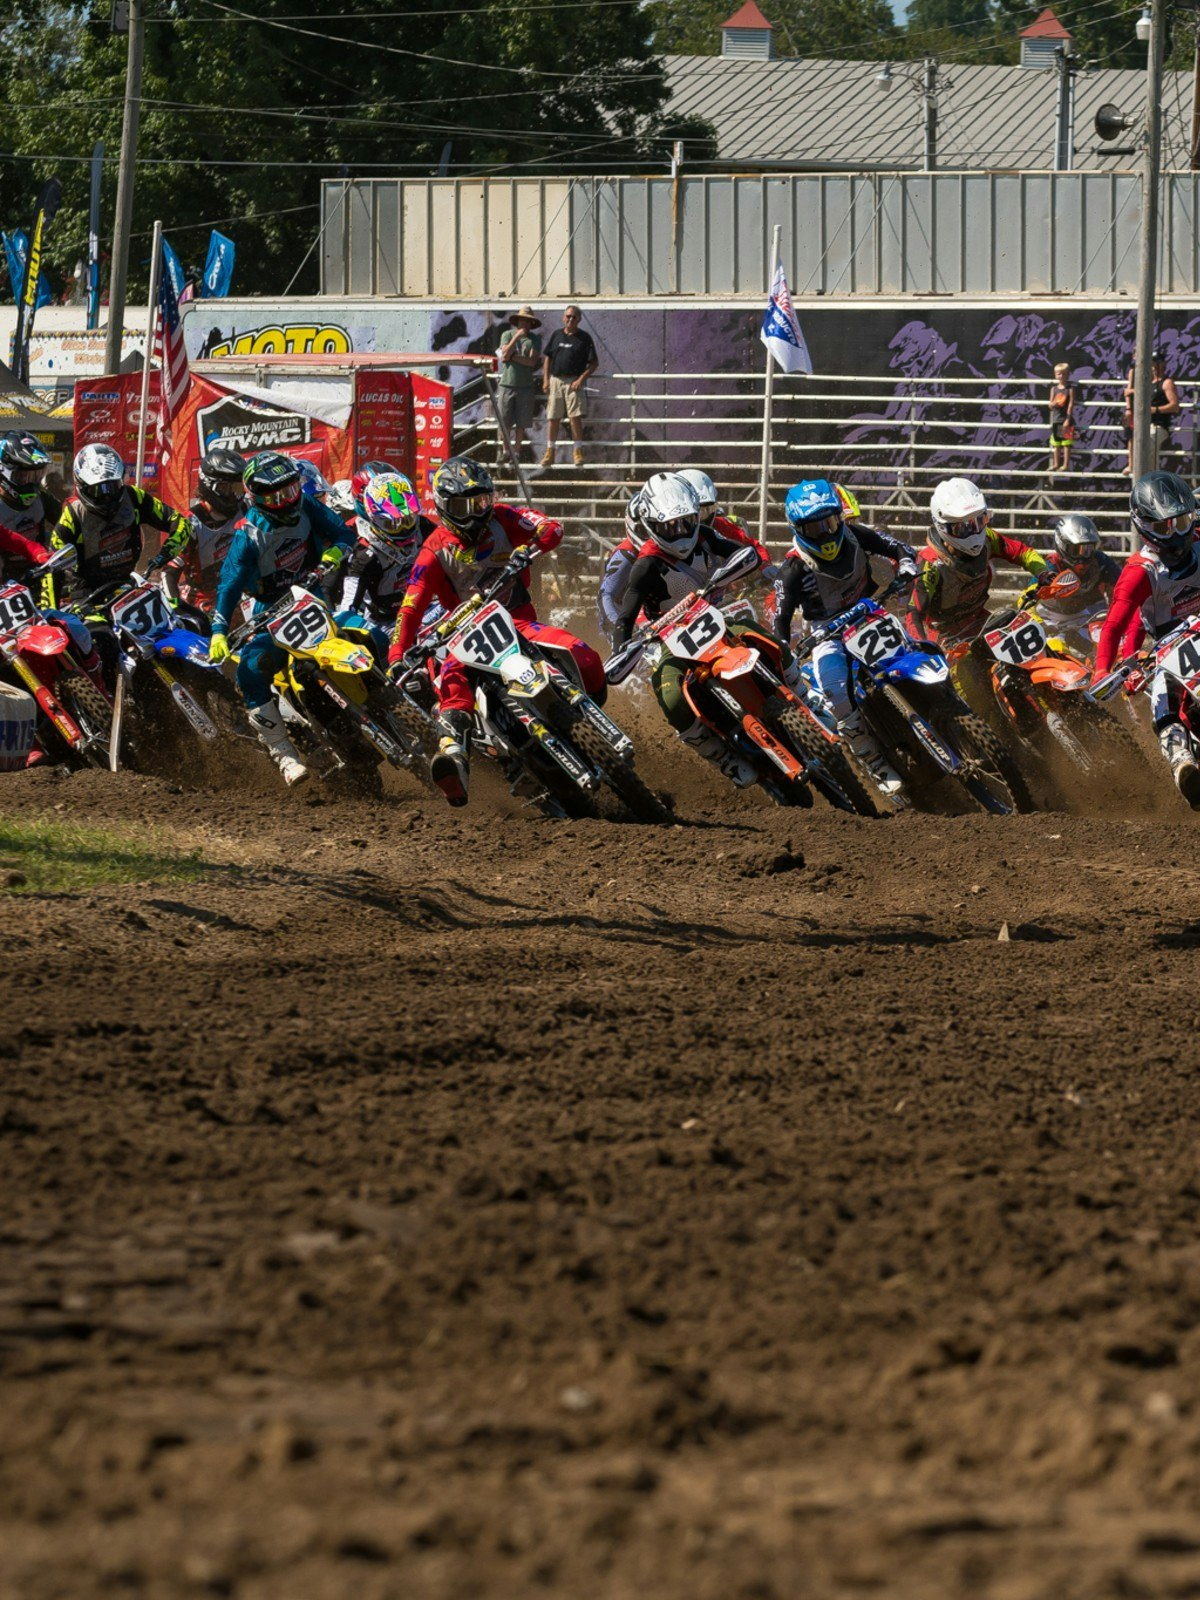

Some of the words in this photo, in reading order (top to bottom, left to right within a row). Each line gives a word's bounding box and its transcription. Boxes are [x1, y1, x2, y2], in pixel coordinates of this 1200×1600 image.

[361, 393, 390, 403] LUCAS
[390, 394, 404, 404] OIL
[221, 425, 250, 438] ROCKY
[251, 418, 300, 435] MOUNTAIN
[121, 590, 163, 637] 37
[283, 605, 326, 649] 99
[676, 612, 721, 656] 13
[463, 612, 514, 664] 30
[858, 618, 900, 666] 25
[1000, 624, 1044, 663] 18
[324, 685, 348, 709] RG3
[754, 726, 790, 761] DLOP
[914, 721, 951, 762] DULOP
